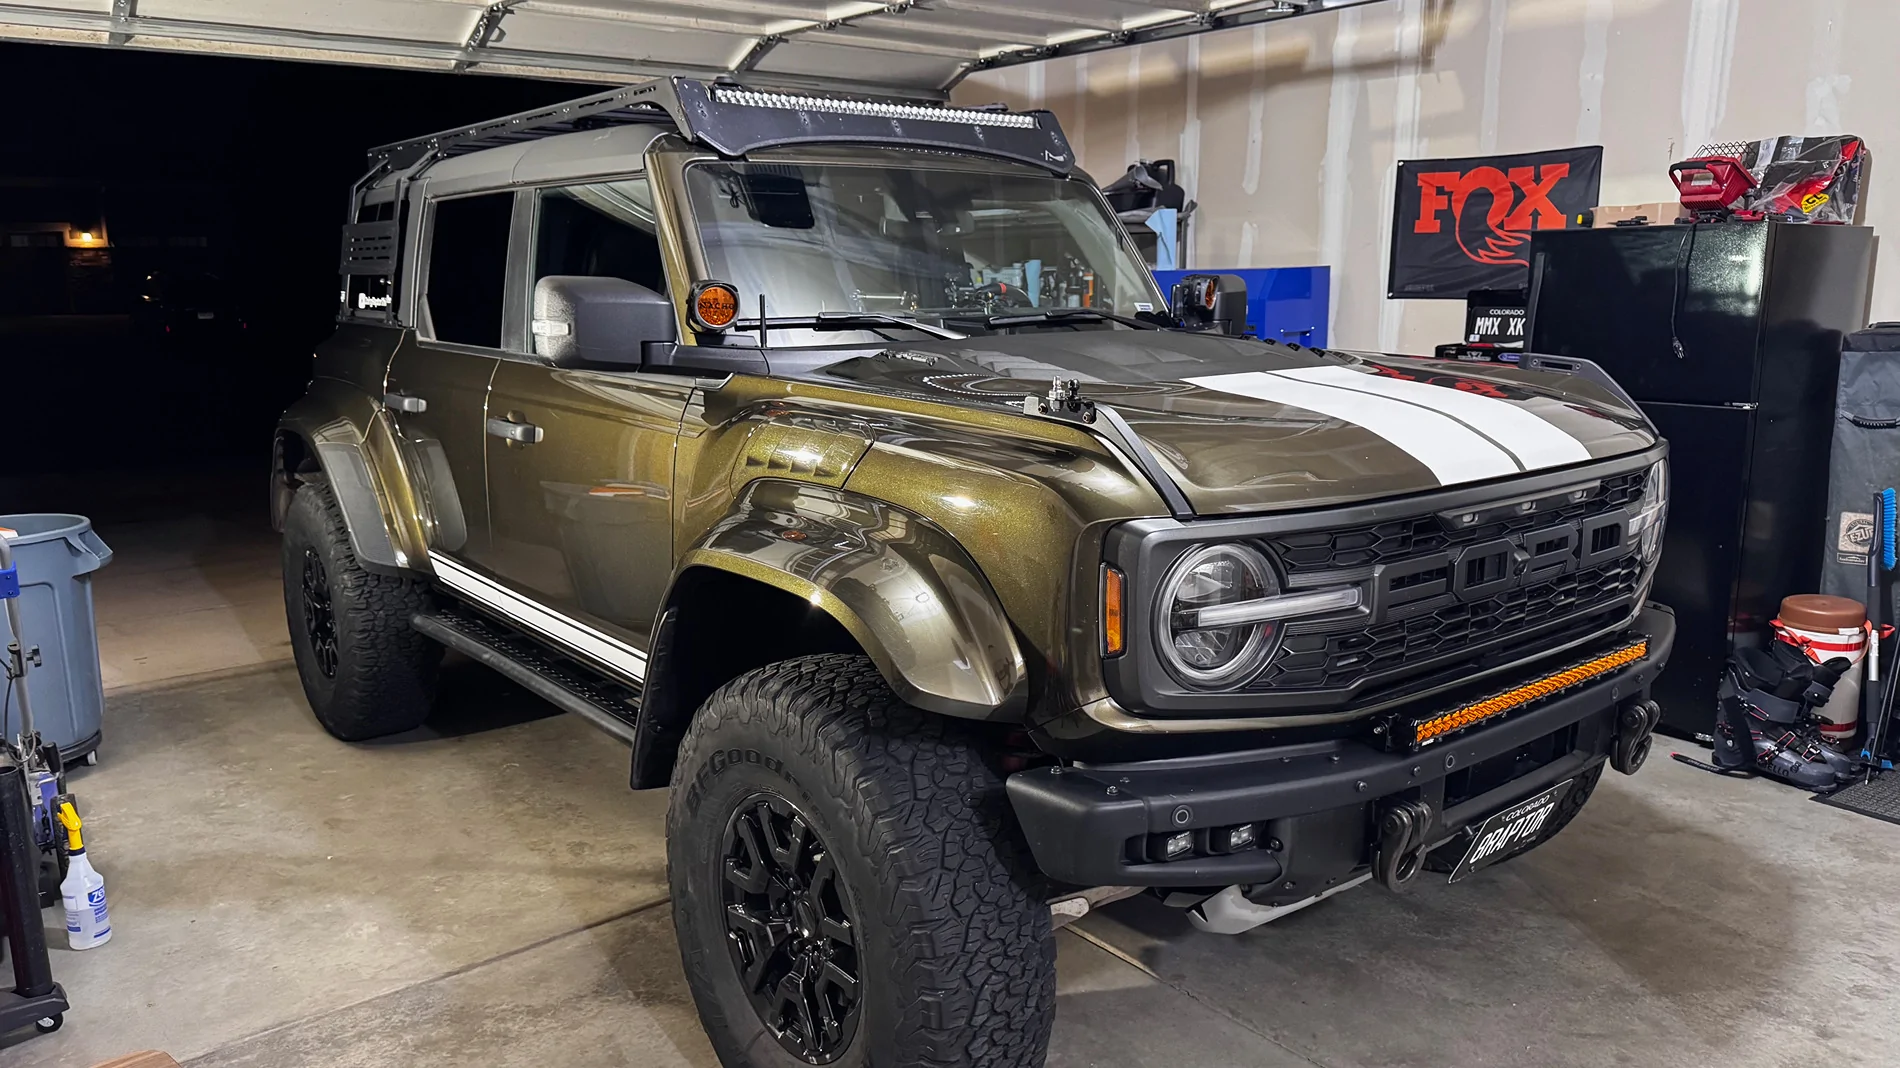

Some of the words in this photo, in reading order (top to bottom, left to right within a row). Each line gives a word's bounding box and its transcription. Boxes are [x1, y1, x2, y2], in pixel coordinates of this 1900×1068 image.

[1414, 163, 1570, 239] FOX
[699, 301, 735, 309] NACHO
[1474, 317, 1501, 335] MMX
[1369, 507, 1630, 624] FORD
[1505, 794, 1550, 821] COLORADO
